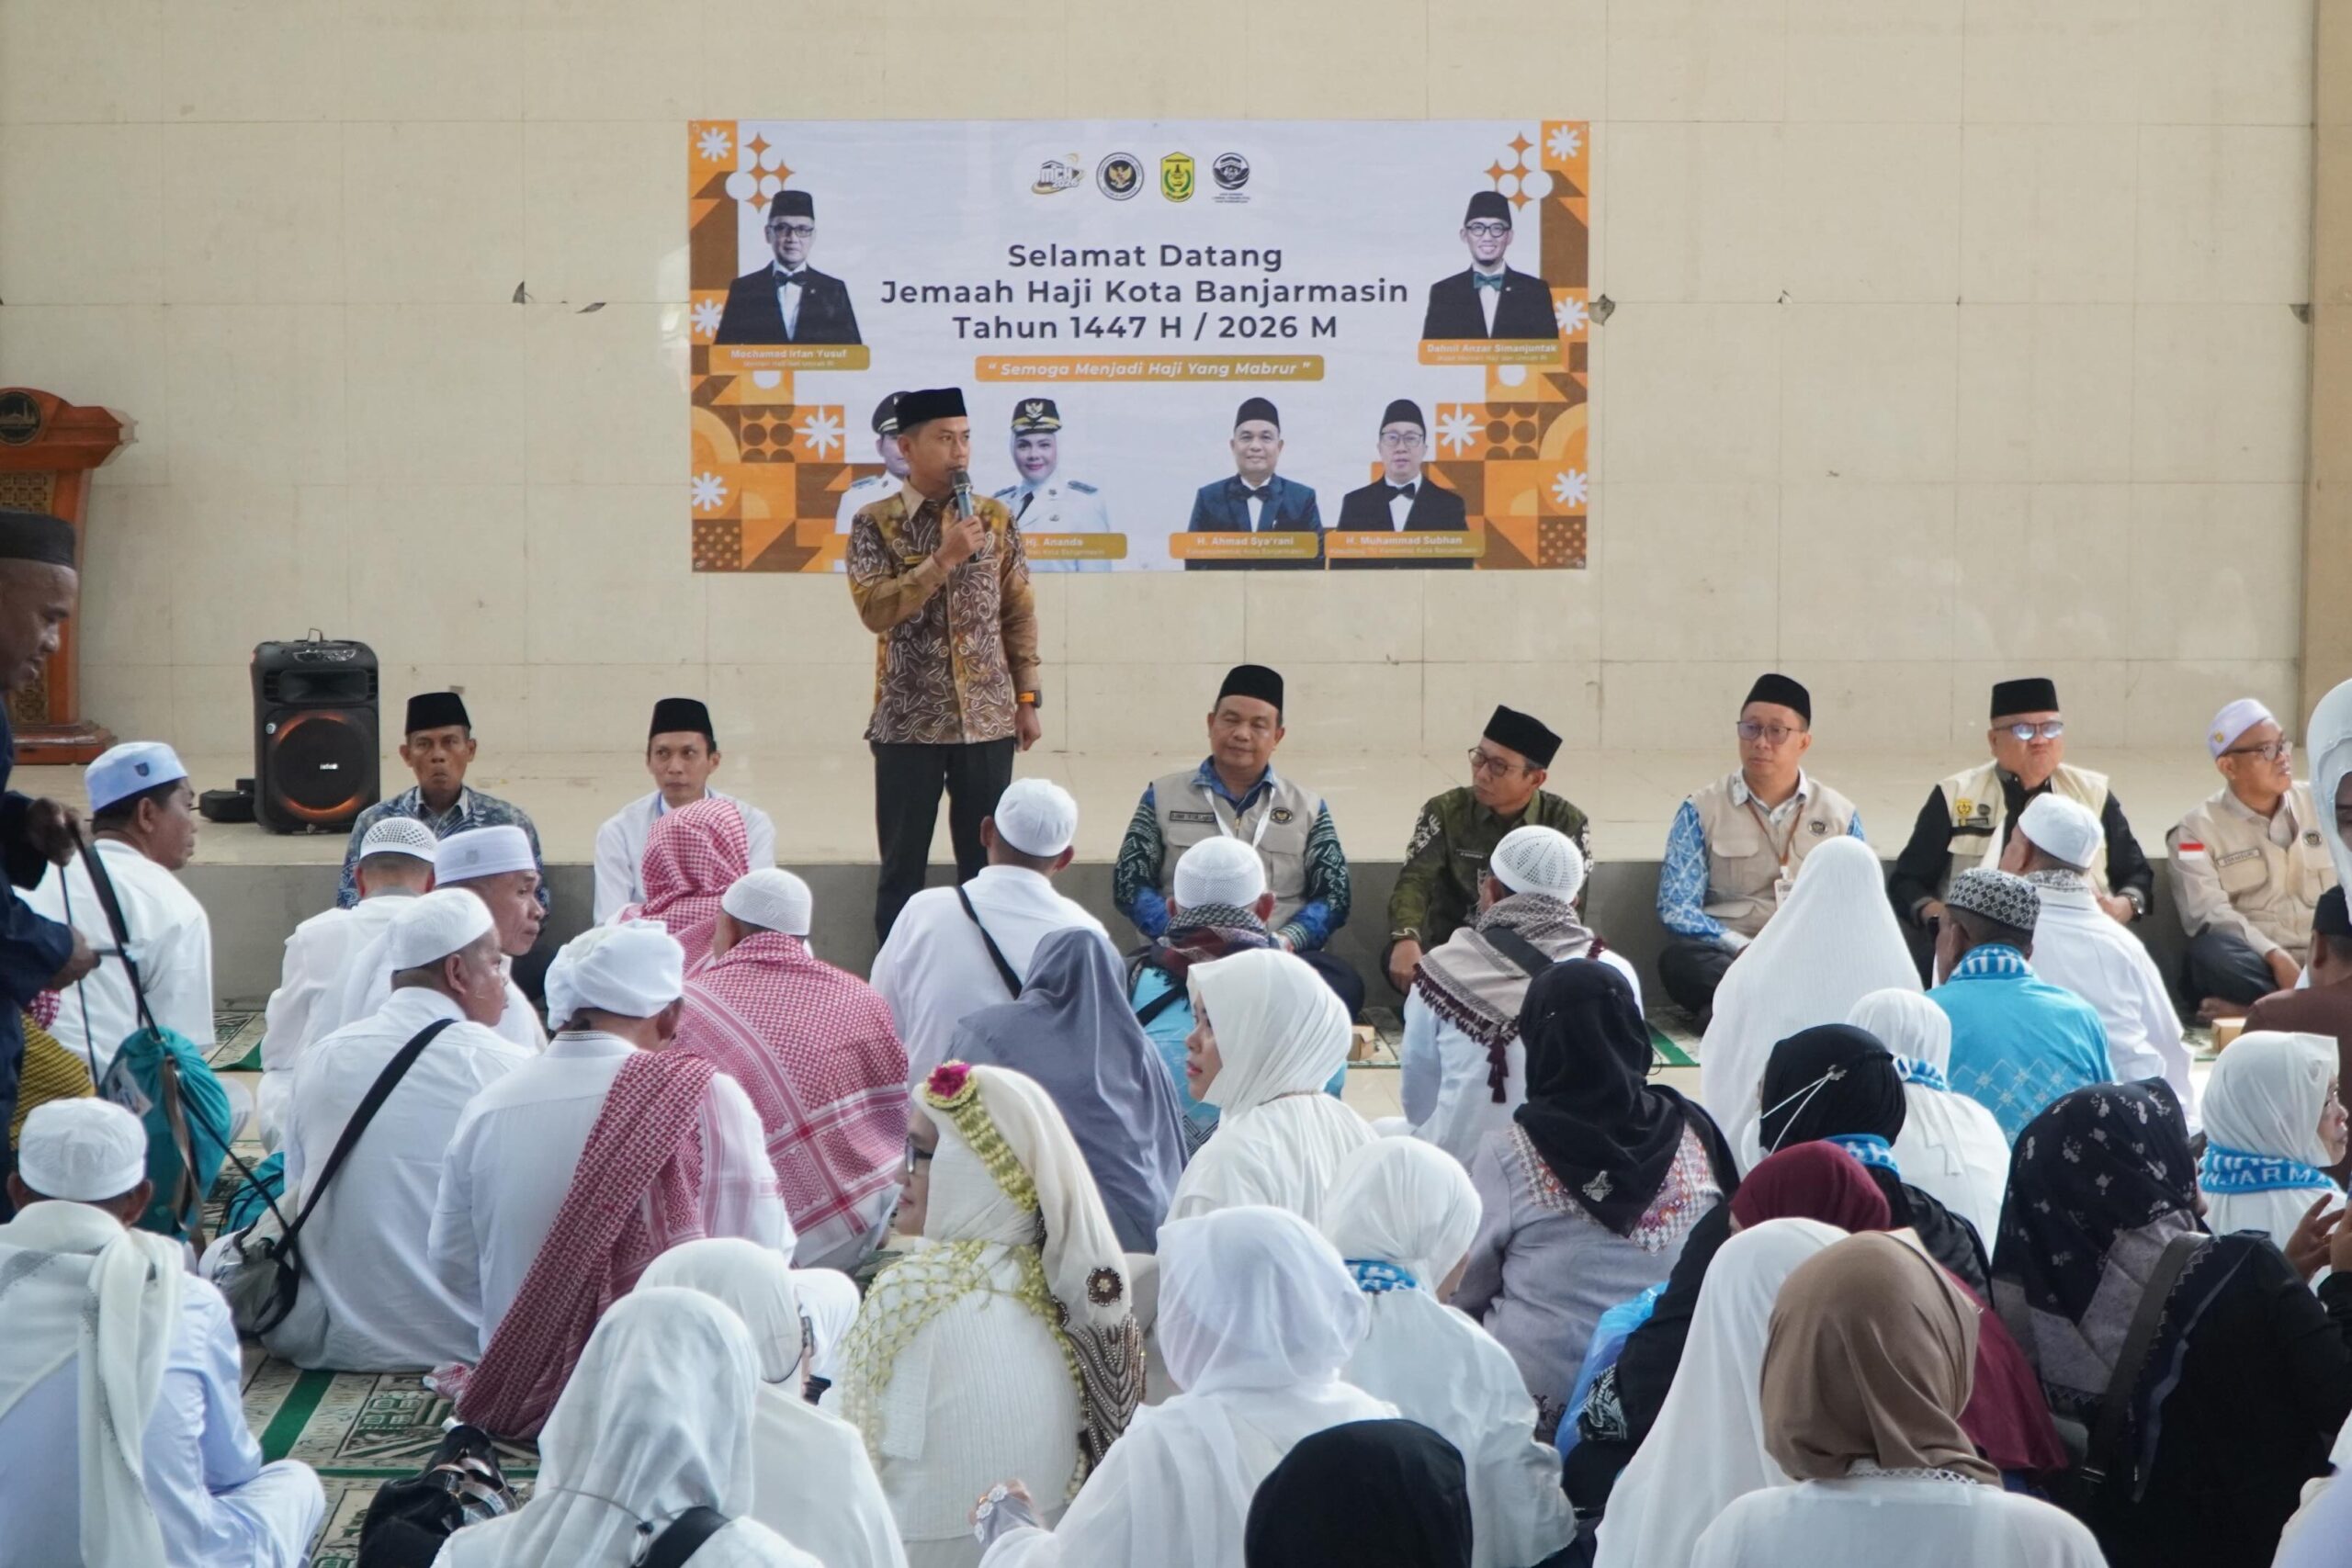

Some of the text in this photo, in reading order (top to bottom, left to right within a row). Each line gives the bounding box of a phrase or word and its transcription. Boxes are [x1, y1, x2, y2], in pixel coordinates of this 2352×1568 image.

[1008, 243, 1282, 273] Selamat Datang
[880, 277, 1408, 310] Jemaah Haji Kota Banjarmasin
[952, 315, 1057, 339] Tahun
[1069, 316, 1147, 339] 1447
[1160, 316, 1182, 339] H
[1218, 315, 1298, 339] 2026
[1311, 315, 1337, 338] M
[788, 349, 814, 358] Irfan
[817, 349, 847, 358] Yusuf
[1427, 344, 1557, 355] Dahnil Anzar Simanjuntak
[1001, 363, 1069, 378] Semoga
[1075, 362, 1143, 378] Menjadi
[1148, 362, 1183, 378] Haji
[1188, 363, 1230, 378] Yang
[1235, 362, 1297, 376] Mabrur
[1043, 538, 1083, 547] Ananda
[1212, 536, 1249, 546] Ahmad
[1360, 536, 1422, 545] Muhammad
[1423, 536, 1464, 545] Subhan
